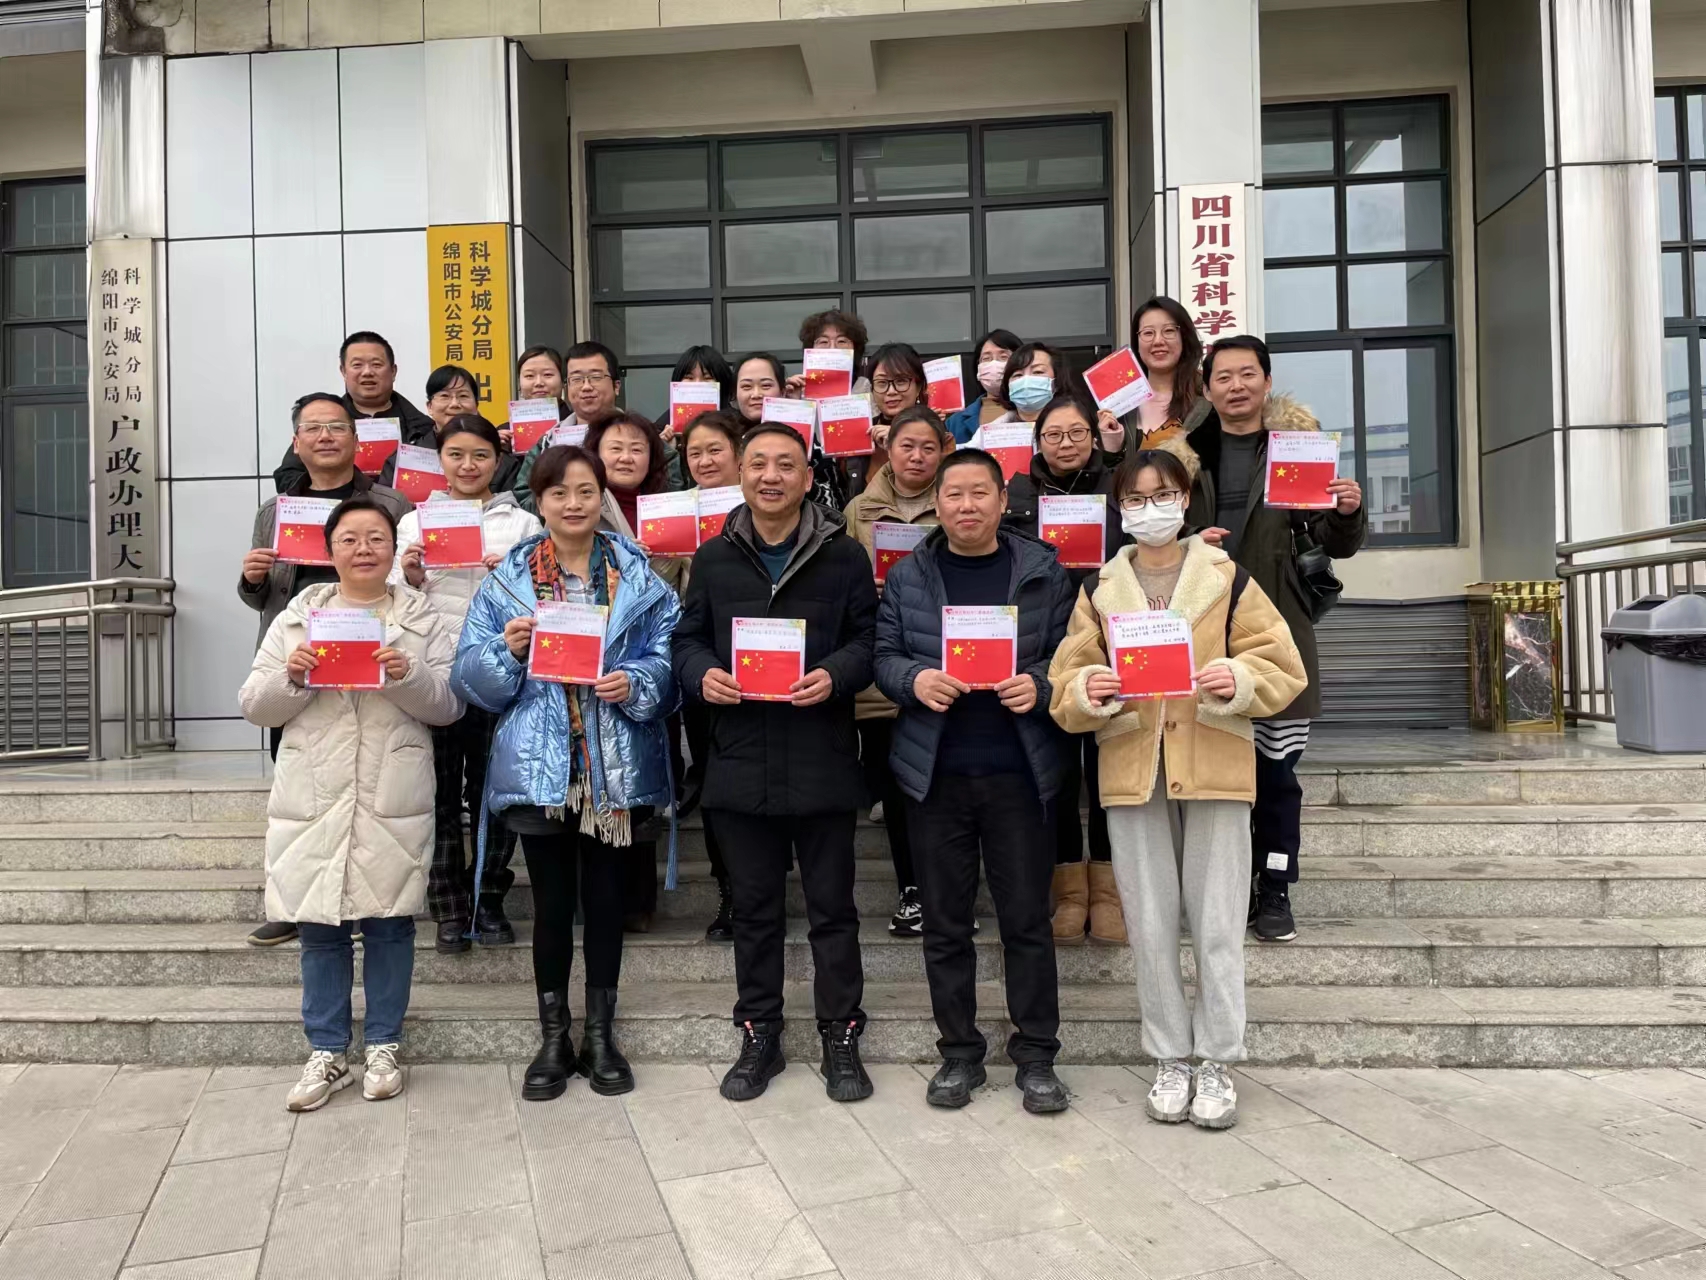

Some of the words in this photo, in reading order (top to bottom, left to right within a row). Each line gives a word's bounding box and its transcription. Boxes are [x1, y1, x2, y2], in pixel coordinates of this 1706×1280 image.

[101, 268, 119, 404] 绵阳市公安局
[123, 267, 142, 403] 科学城分局
[442, 242, 463, 361] 绵阳市公安局
[469, 240, 493, 360] 科学城分局
[1191, 195, 1237, 355] 四川省科学
